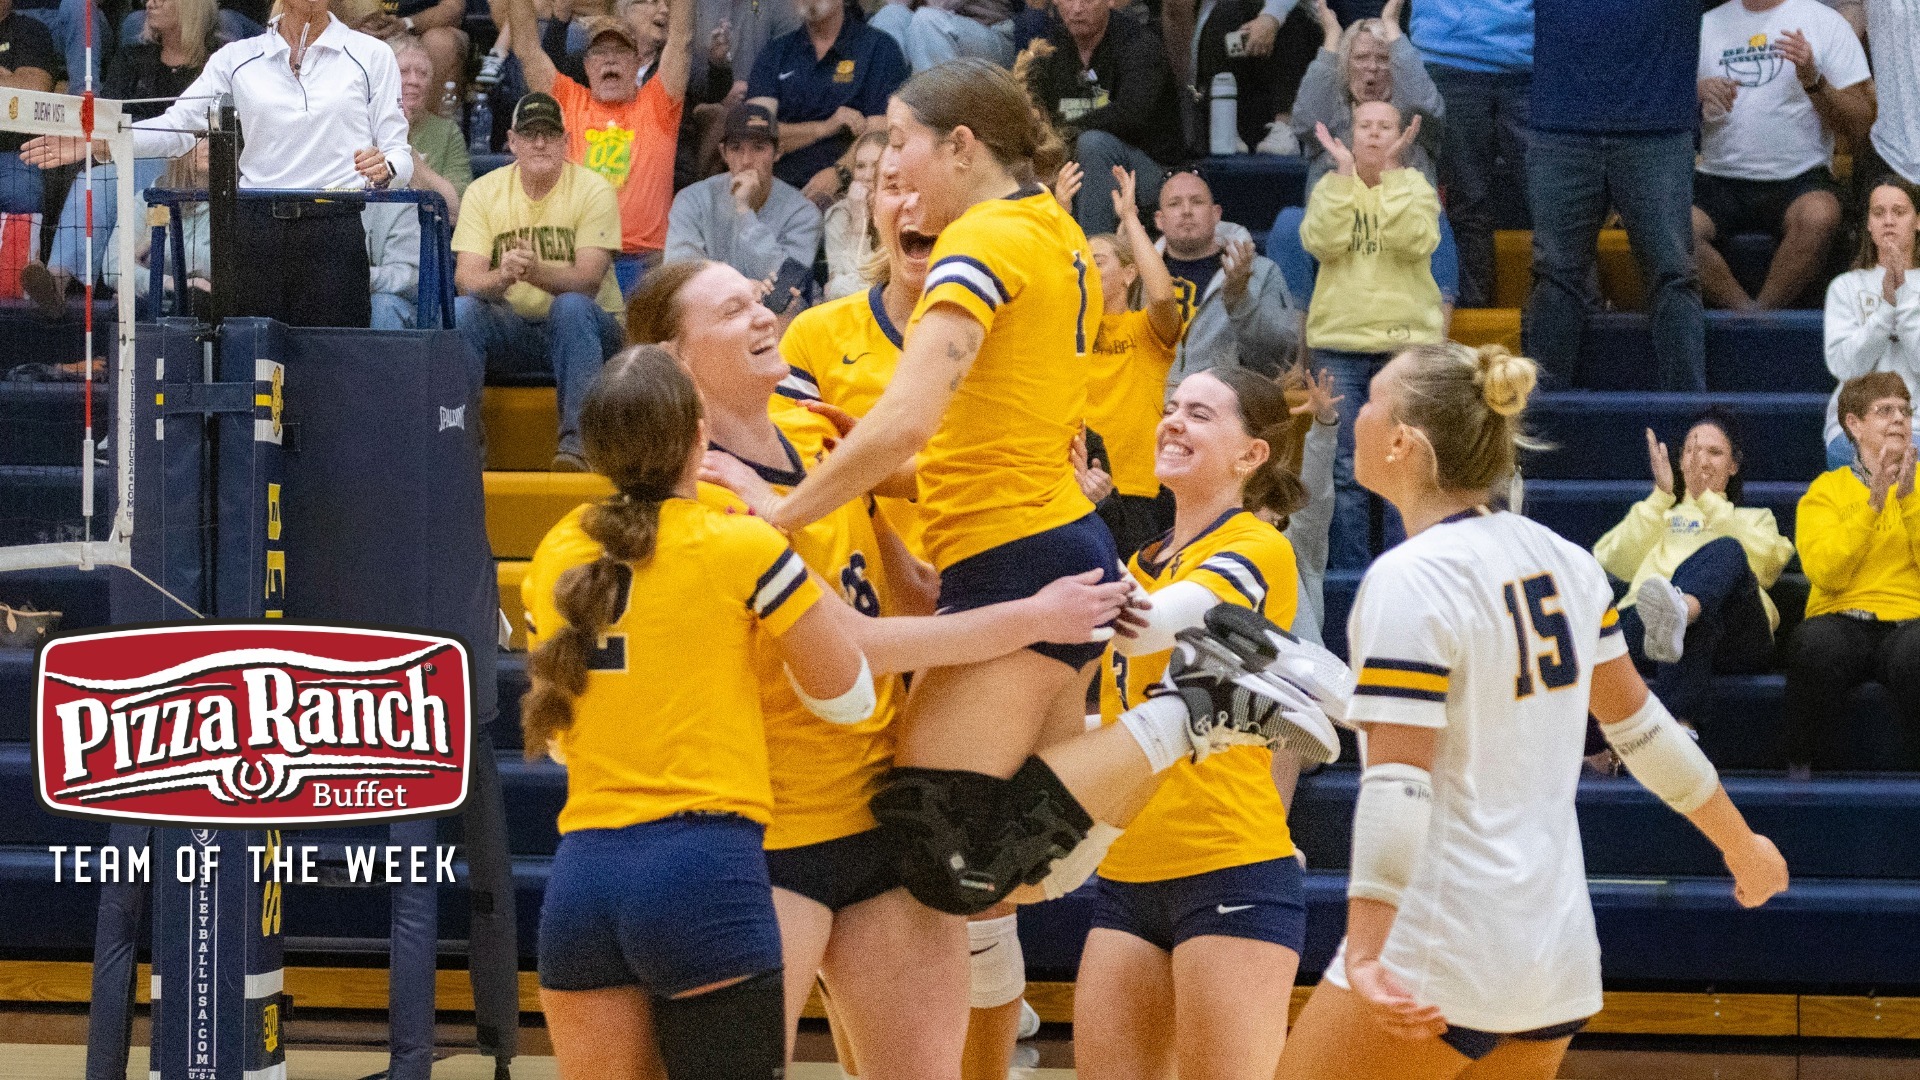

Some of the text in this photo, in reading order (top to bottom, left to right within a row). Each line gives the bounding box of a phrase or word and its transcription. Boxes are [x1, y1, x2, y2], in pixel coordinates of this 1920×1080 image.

[34, 101, 65, 123] BUENA VISTA
[1072, 250, 1088, 357] 1
[1503, 570, 1580, 702] 15
